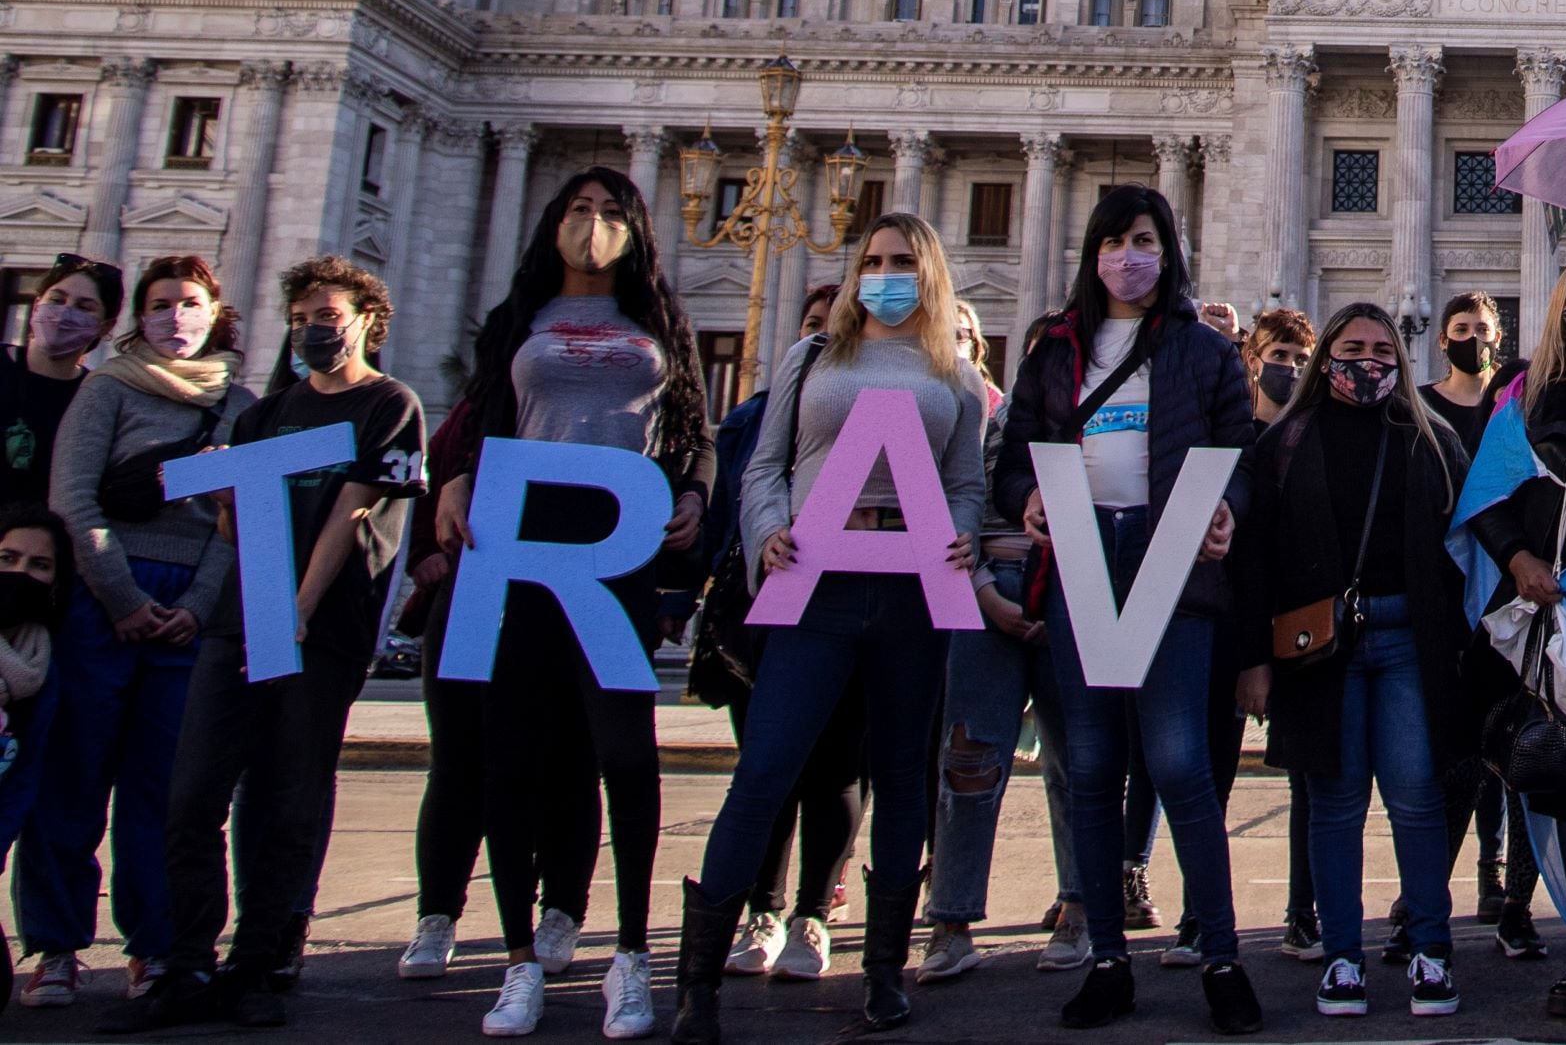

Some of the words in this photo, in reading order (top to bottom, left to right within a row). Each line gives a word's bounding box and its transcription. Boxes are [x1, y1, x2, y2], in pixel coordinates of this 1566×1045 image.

[163, 421, 355, 682] T
[437, 437, 674, 692] R
[744, 389, 985, 630] A
[1029, 442, 1242, 687] V
[378, 449, 422, 481] 31
